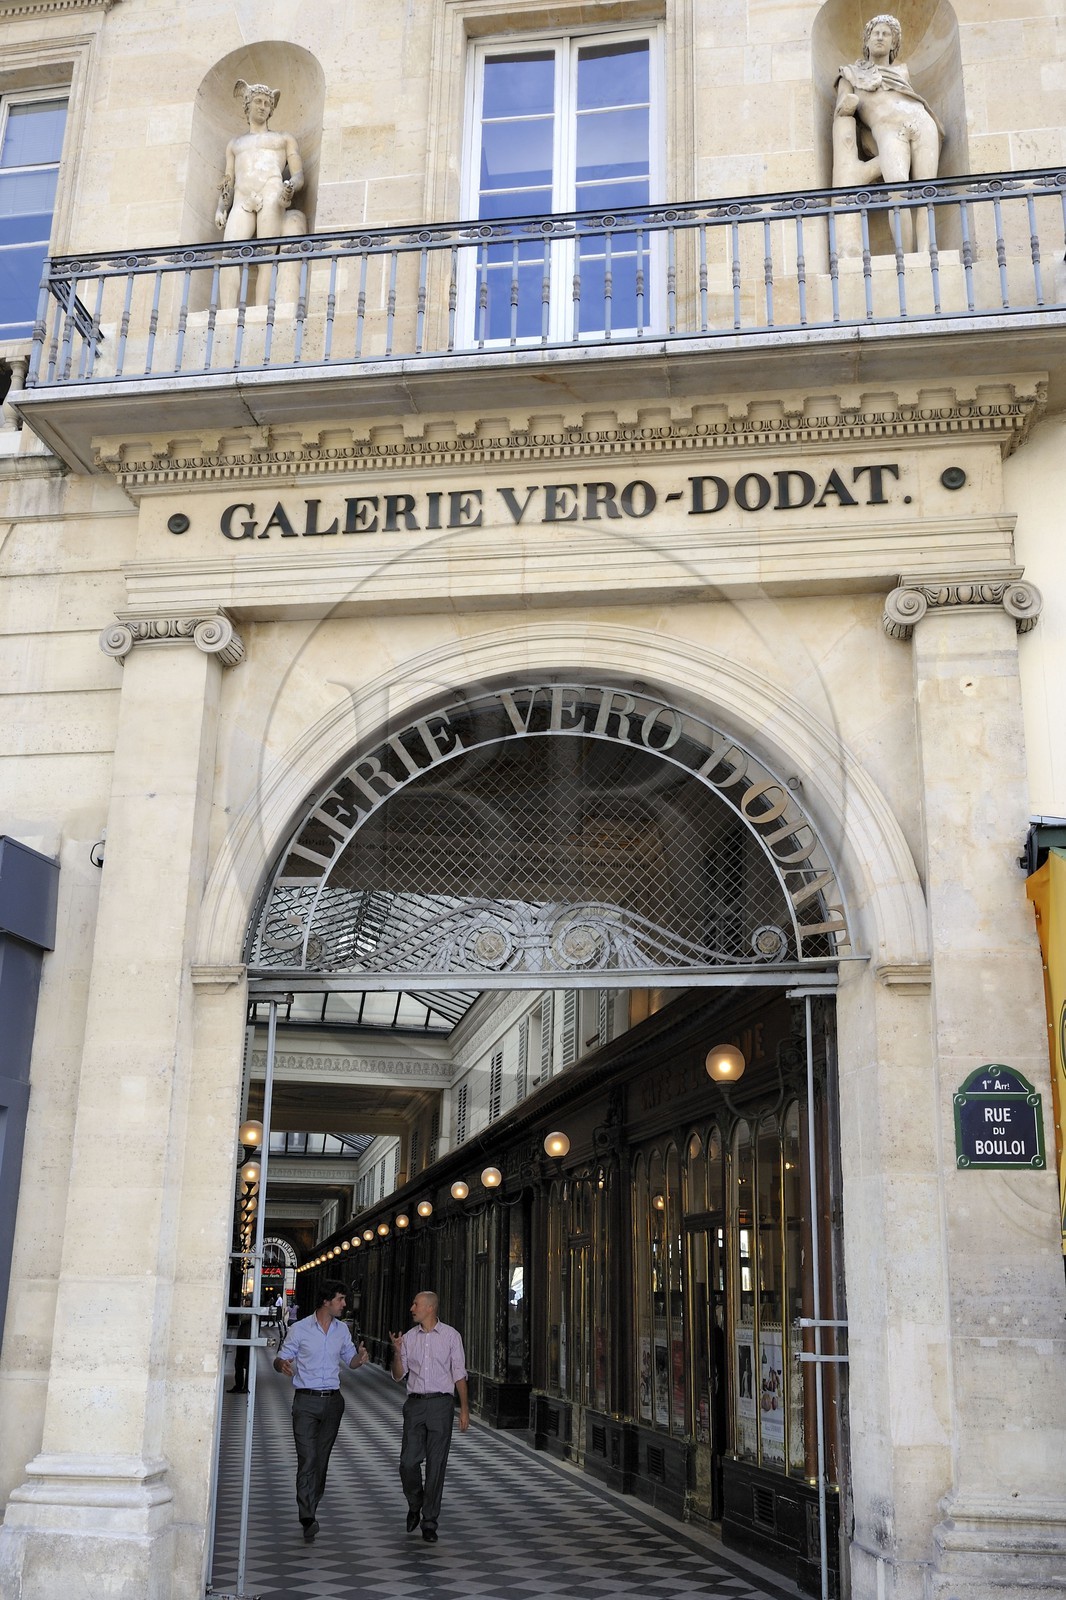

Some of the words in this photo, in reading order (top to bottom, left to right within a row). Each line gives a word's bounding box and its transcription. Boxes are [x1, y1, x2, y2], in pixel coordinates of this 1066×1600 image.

[220, 488, 484, 540] GALERIE
[262, 706, 464, 951] GALERIE
[497, 685, 683, 752] VERO
[695, 738, 852, 947] DODAT
[984, 1108, 1012, 1122] RUE
[993, 1127, 1005, 1135] DU
[975, 1140, 1025, 1155] BOULOI
